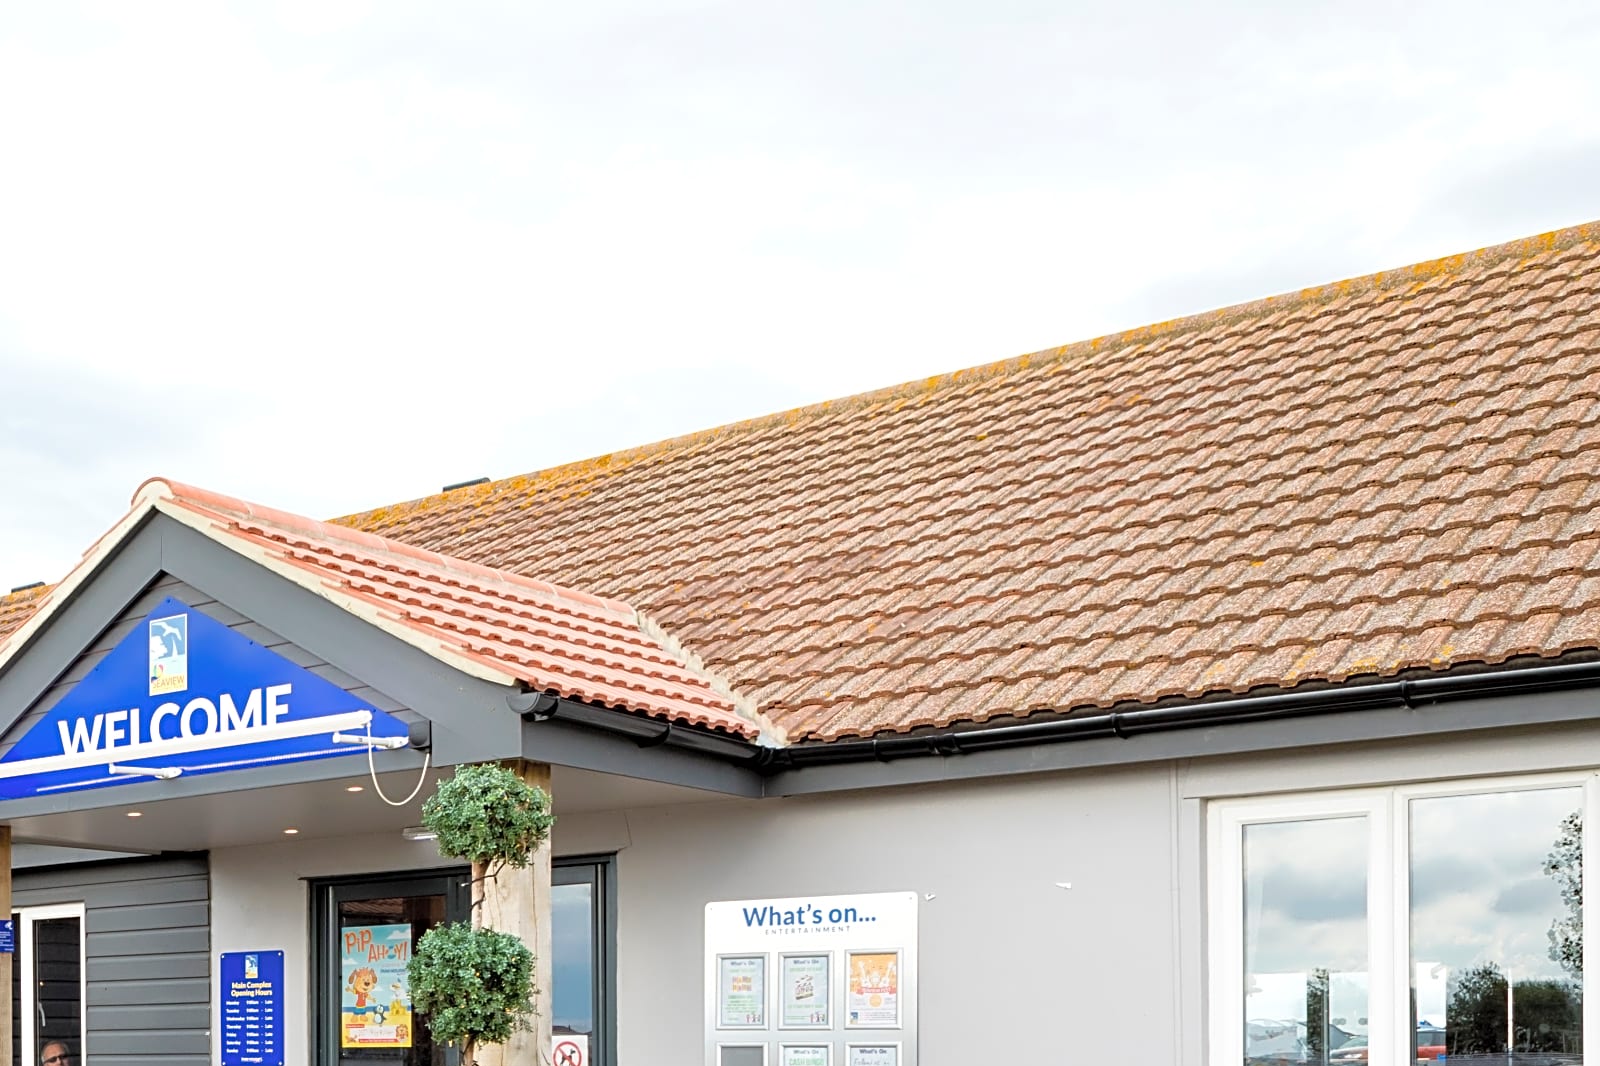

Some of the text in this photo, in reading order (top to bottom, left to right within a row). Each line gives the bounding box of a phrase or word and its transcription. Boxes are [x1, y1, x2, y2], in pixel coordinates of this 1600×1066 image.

[152, 674, 185, 689] SEAVIEW
[57, 683, 292, 755] WELCOME
[765, 925, 851, 936] ENTERTAINMENT
